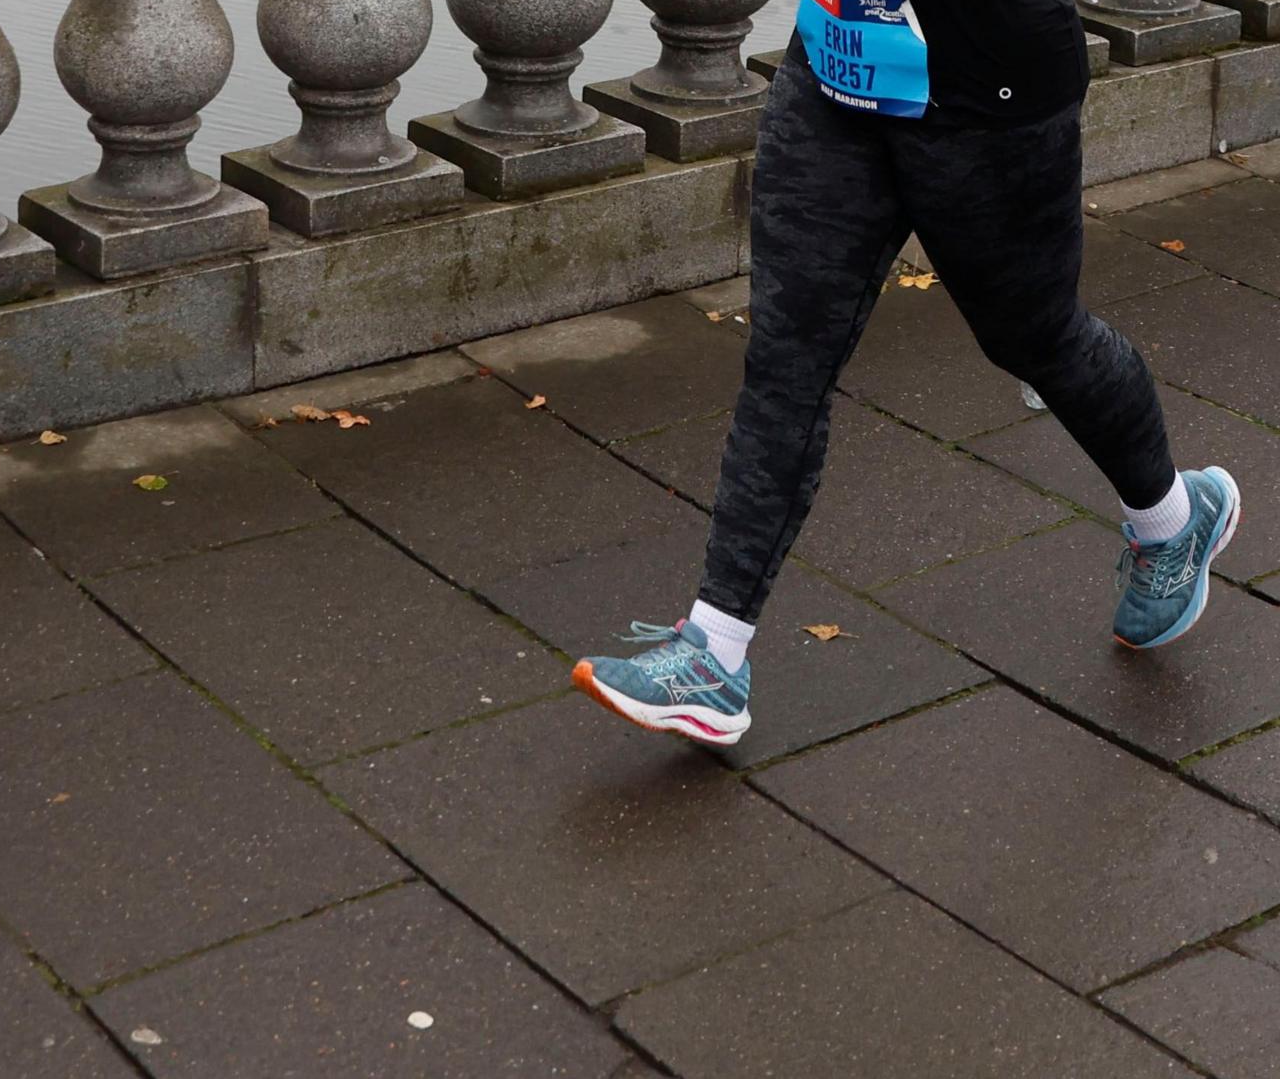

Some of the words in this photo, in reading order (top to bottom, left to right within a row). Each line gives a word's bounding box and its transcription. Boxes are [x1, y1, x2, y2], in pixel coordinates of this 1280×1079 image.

[825, 20, 863, 59] ERIN
[819, 48, 876, 92] 18257
[820, 83, 834, 98] HALF
[834, 92, 878, 110] MARATHON
